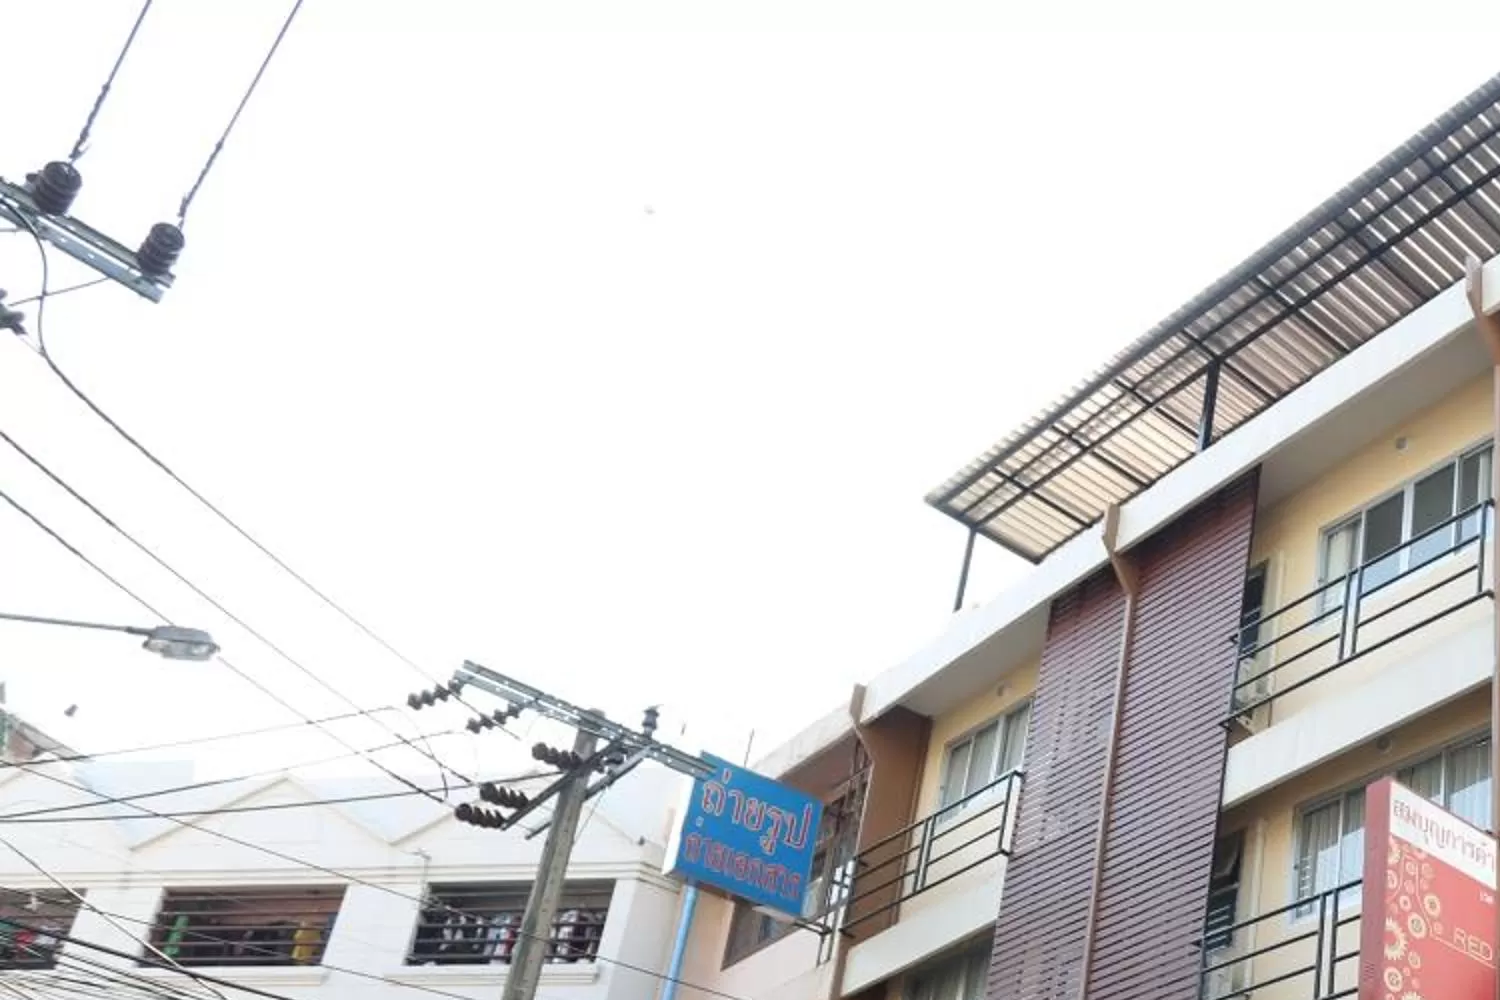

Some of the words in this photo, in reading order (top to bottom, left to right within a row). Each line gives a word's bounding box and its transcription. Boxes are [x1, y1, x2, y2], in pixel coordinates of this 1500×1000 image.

[702, 767, 813, 856] ถ่ายรูป
[1453, 928, 1493, 961] RED
